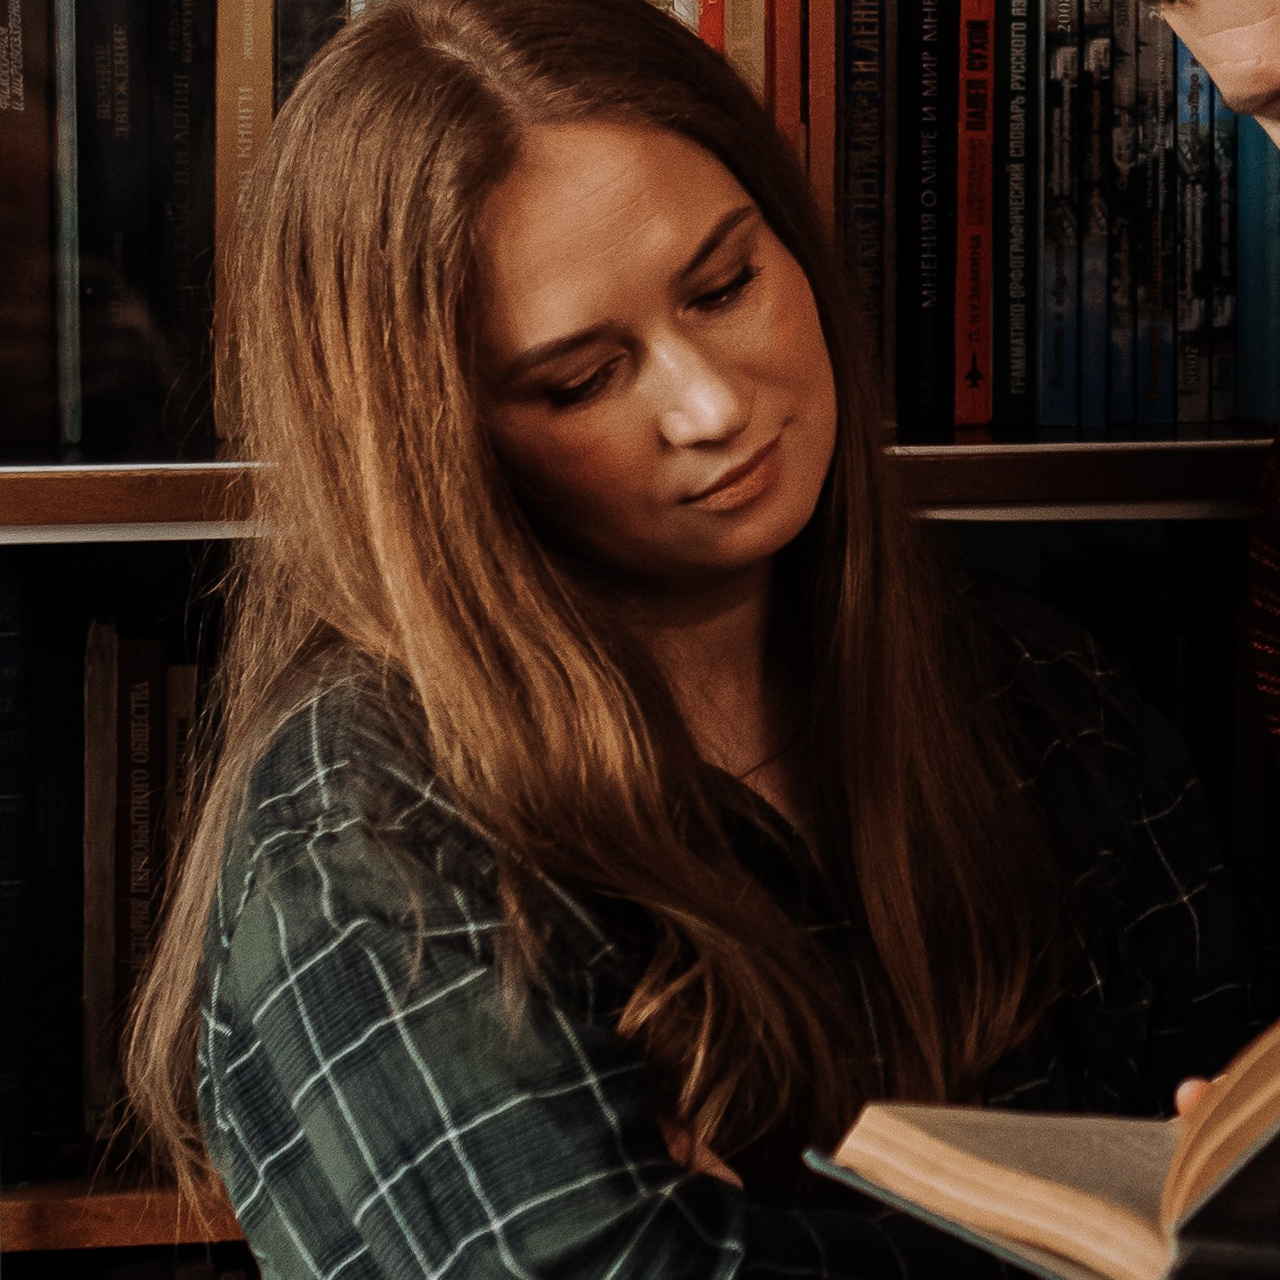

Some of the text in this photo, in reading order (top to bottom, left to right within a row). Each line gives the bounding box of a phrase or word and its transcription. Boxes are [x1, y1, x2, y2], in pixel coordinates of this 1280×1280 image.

[918, 50, 937, 98] МИР
[966, 19, 988, 71] СУХОЙ
[1009, 21, 1027, 91] РУССКОГО
[112, 23, 132, 139] ДВИЖЕНИЕ
[919, 105, 937, 123] И
[965, 78, 987, 132] ПАВЕЛ
[237, 86, 254, 158] КНИГИ
[1008, 95, 1026, 158] СЛОВАРЬ
[919, 129, 938, 184] МИРЕ
[919, 188, 938, 209] О
[920, 211, 938, 309] МНЕНИЯ
[969, 234, 983, 323] КУЗЬМИНА
[1008, 162, 1027, 396] ГРАММАТИКО-ОРФОГРАФИЧЕСКИЙ
[1184, 345, 1200, 388] 2008
[130, 680, 152, 764] ОБЩЕСТВА
[130, 768, 151, 894] ПЕРВОБЫТНОГО
